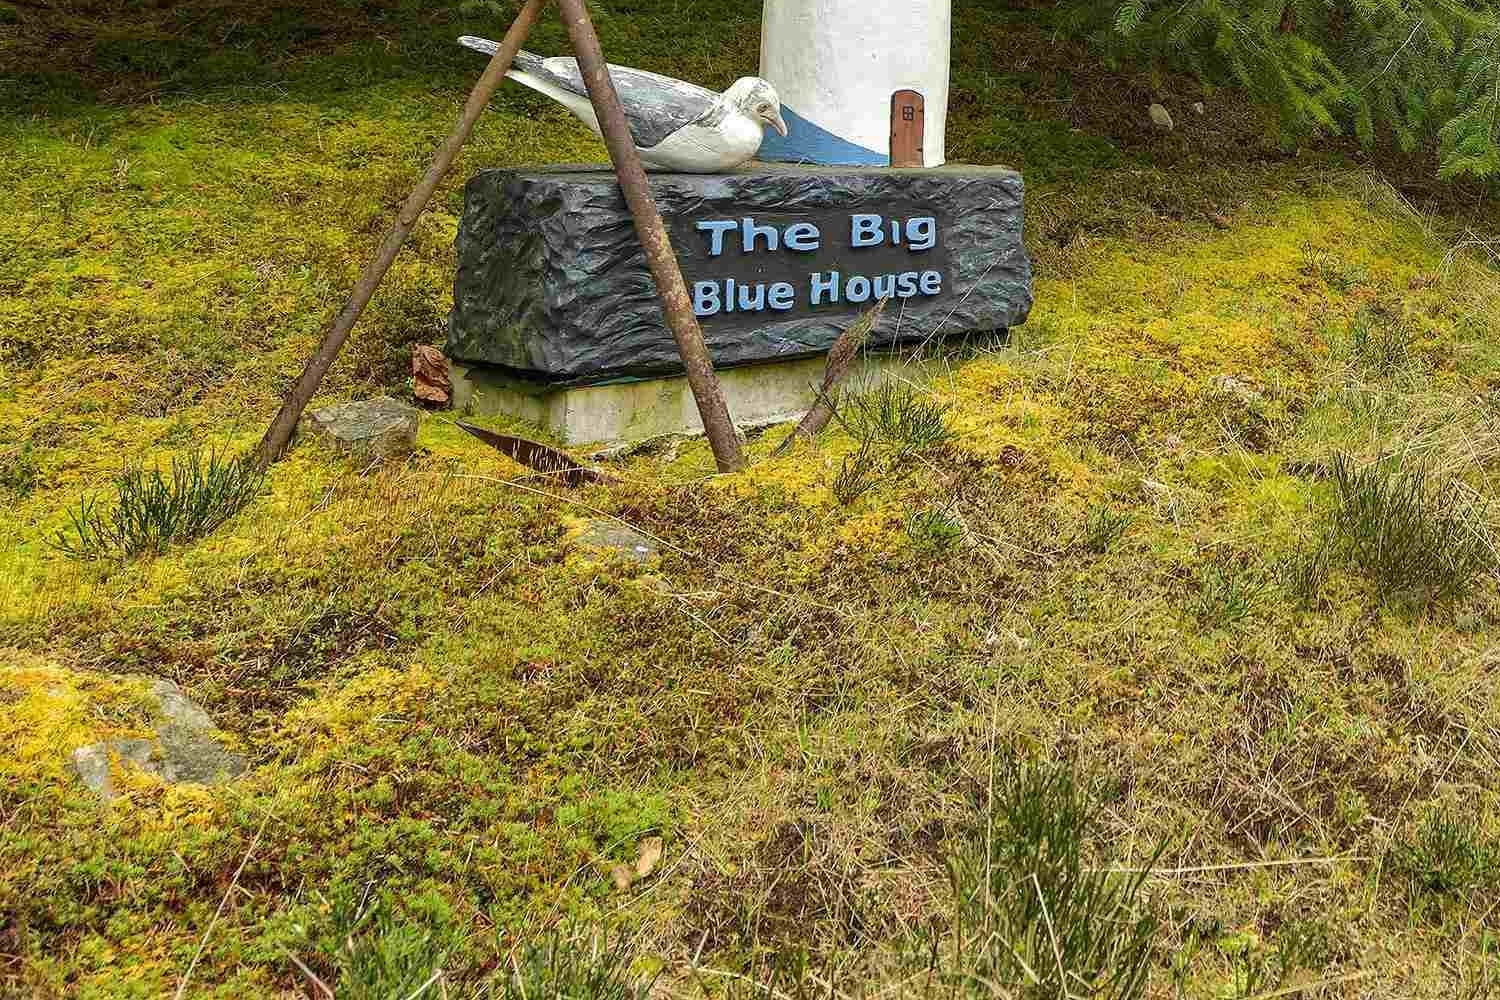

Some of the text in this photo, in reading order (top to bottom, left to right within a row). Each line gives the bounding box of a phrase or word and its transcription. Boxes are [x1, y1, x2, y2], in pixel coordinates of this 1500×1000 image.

[695, 213, 938, 257] The Big
[692, 269, 943, 317] Blue House
